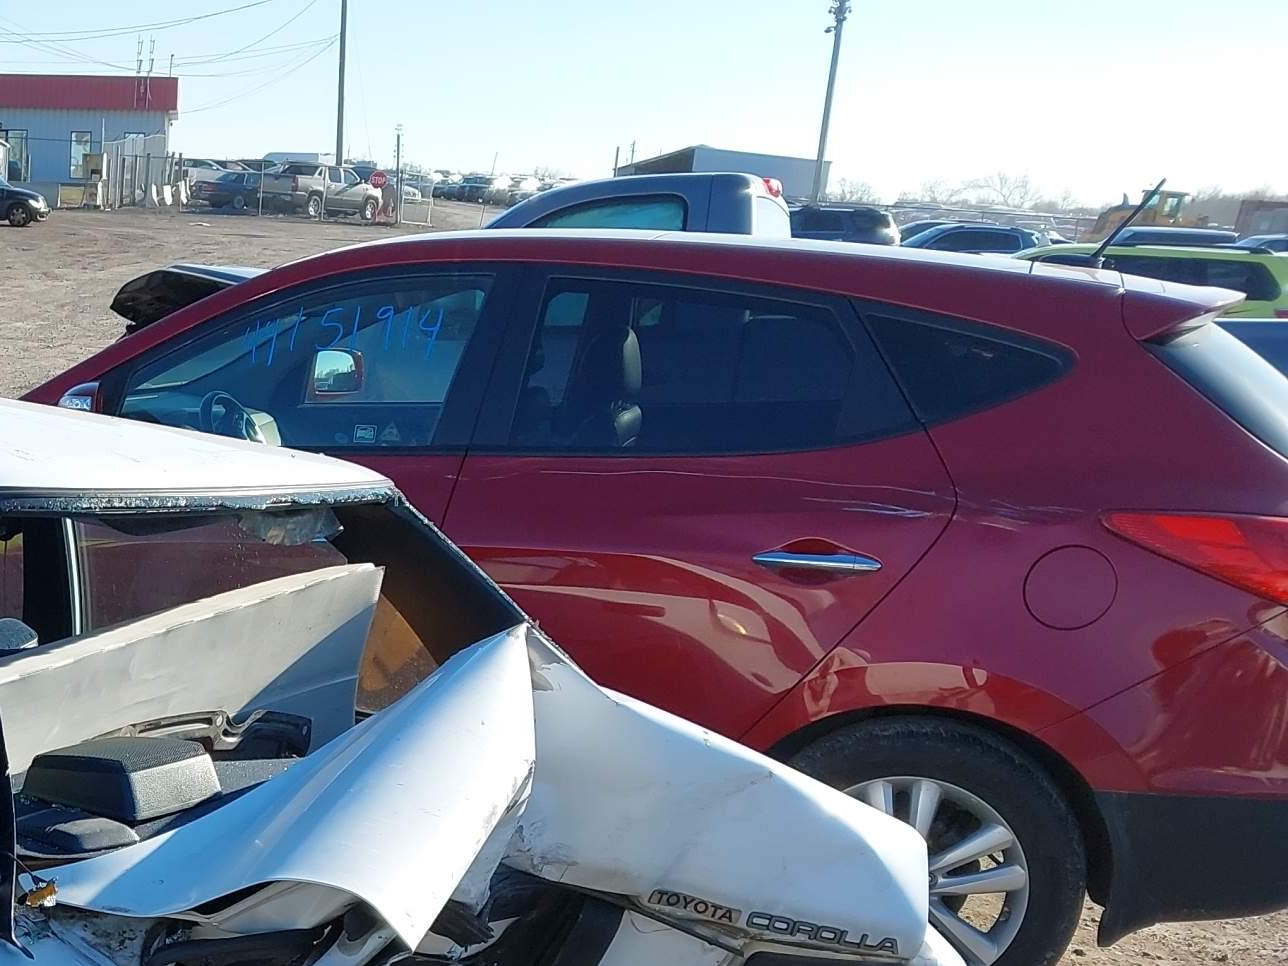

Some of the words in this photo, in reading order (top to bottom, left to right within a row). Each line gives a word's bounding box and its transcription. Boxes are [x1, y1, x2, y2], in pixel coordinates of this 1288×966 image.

[372, 176, 386, 184] STOP
[655, 890, 735, 923] TOYOTA
[746, 911, 899, 955] COROLLA
